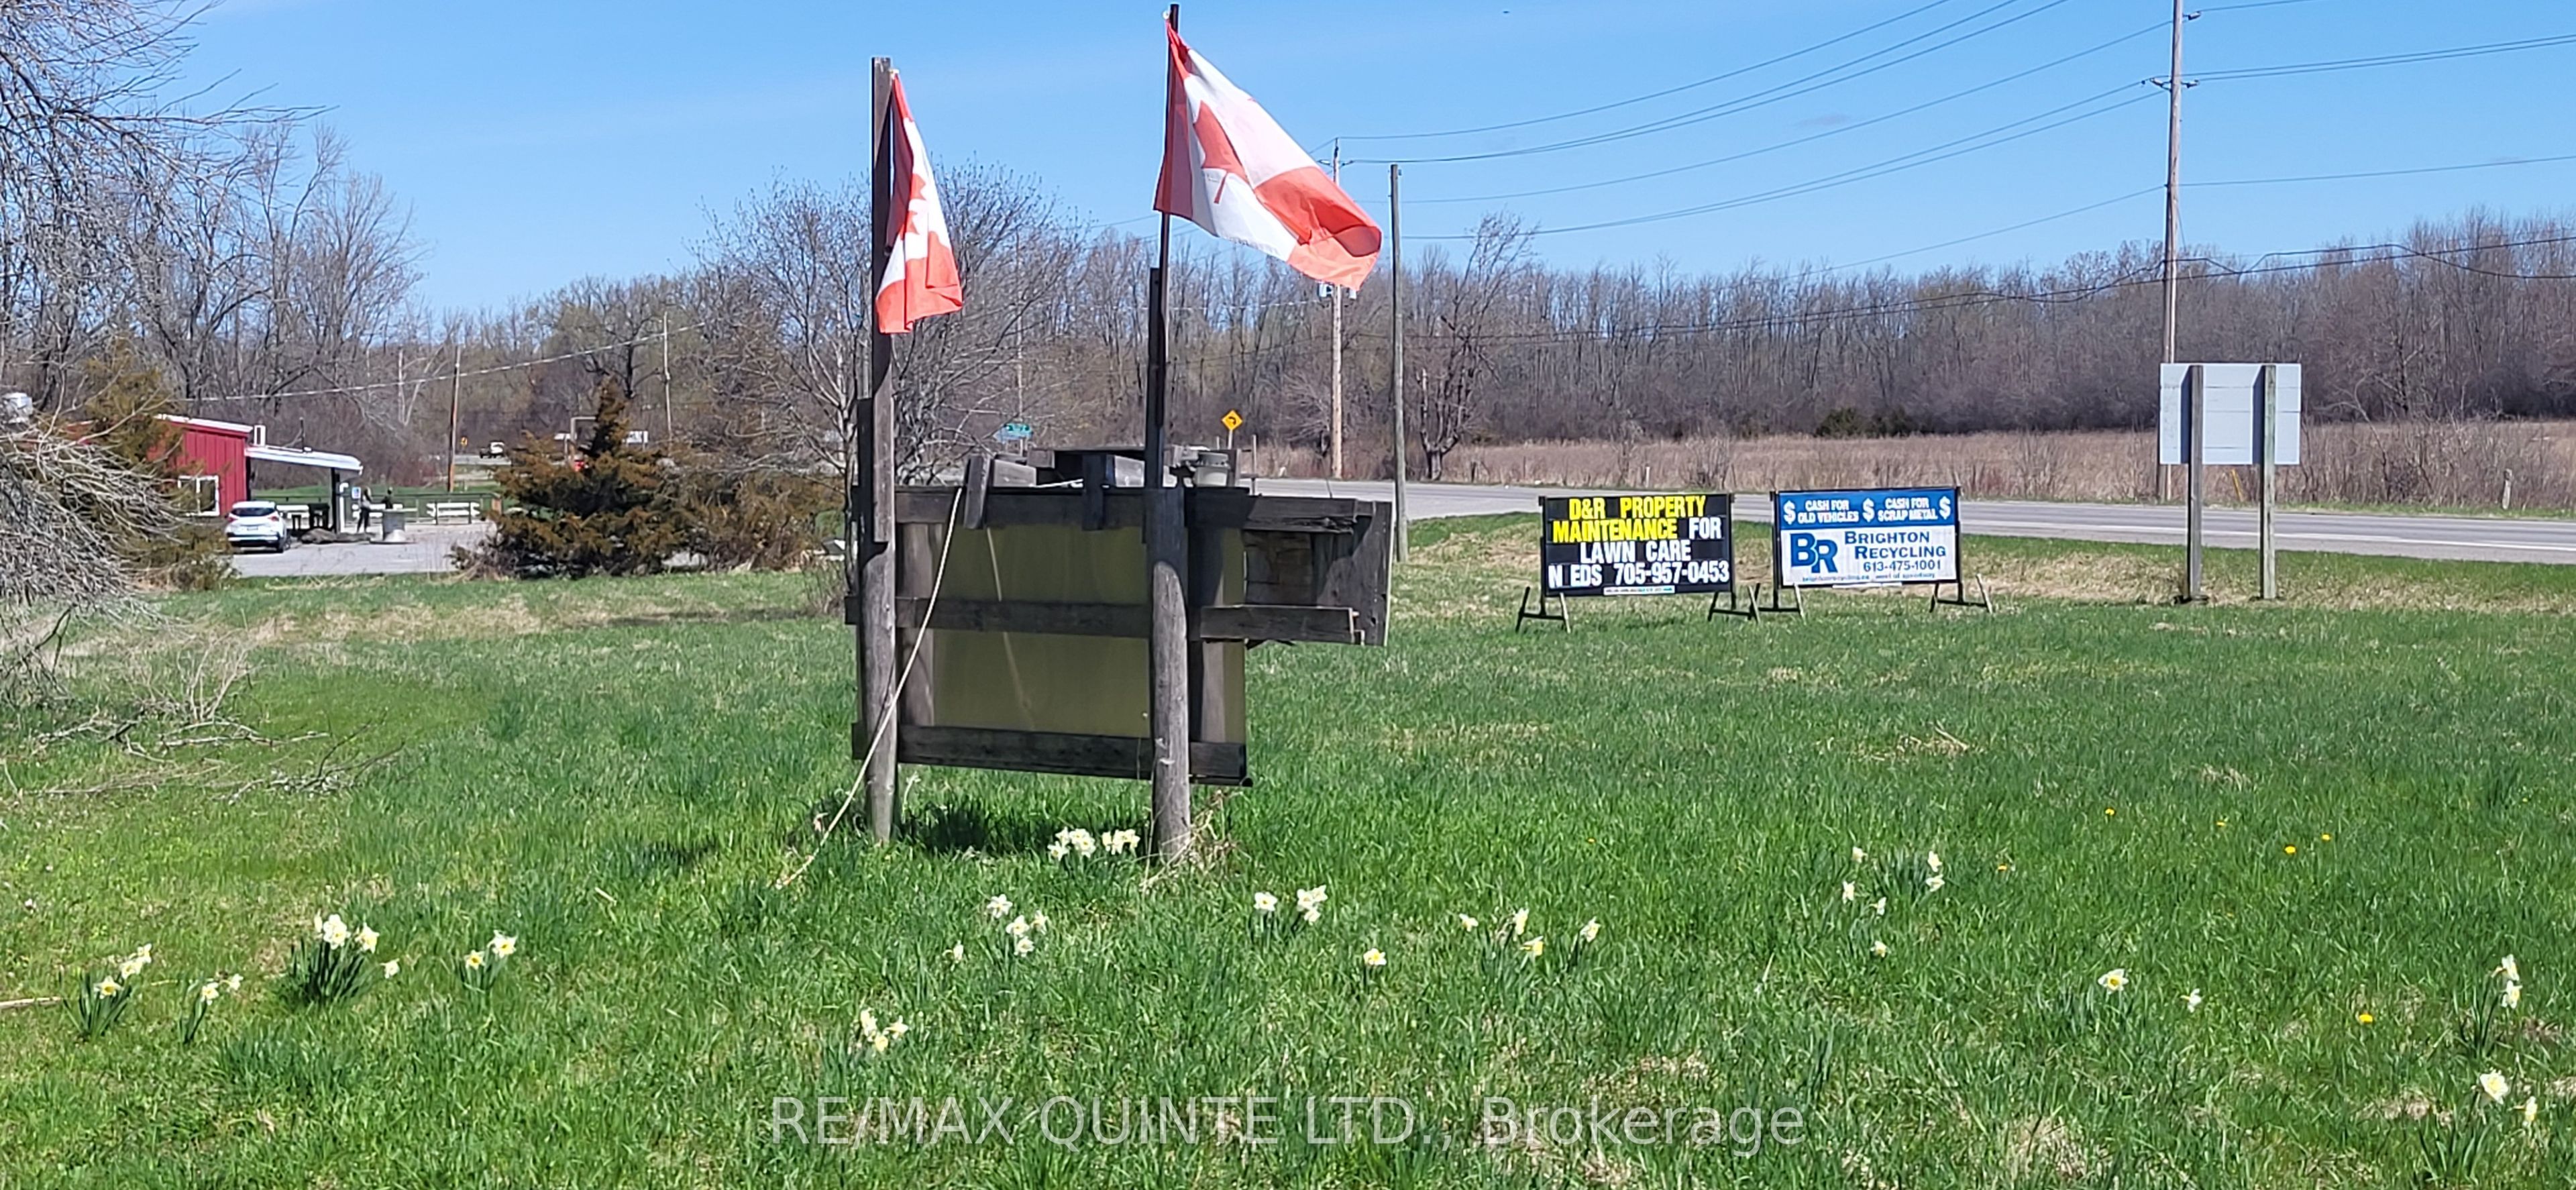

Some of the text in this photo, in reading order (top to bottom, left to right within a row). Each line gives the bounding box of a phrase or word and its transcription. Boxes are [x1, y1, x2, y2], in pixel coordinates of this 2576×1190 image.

[1569, 495, 1707, 520] D&R PROPERTY
[1805, 500, 1849, 511] CASH FOR
[1885, 497, 1929, 509] CASH FOR
[1798, 510, 1859, 523] OLD VEHICLES
[1878, 508, 1938, 521] SCRAP METAL
[1553, 517, 1722, 543] MAINTENANCE FOR
[1845, 531, 1930, 545] BRIGHTON
[1580, 539, 1691, 563] LAWN CARE
[1790, 533, 1838, 574] BR
[1855, 546, 1946, 559] RECYCLING
[1864, 560, 1941, 572] 613-475-1001
[1614, 561, 1729, 585] 705-957-0453
